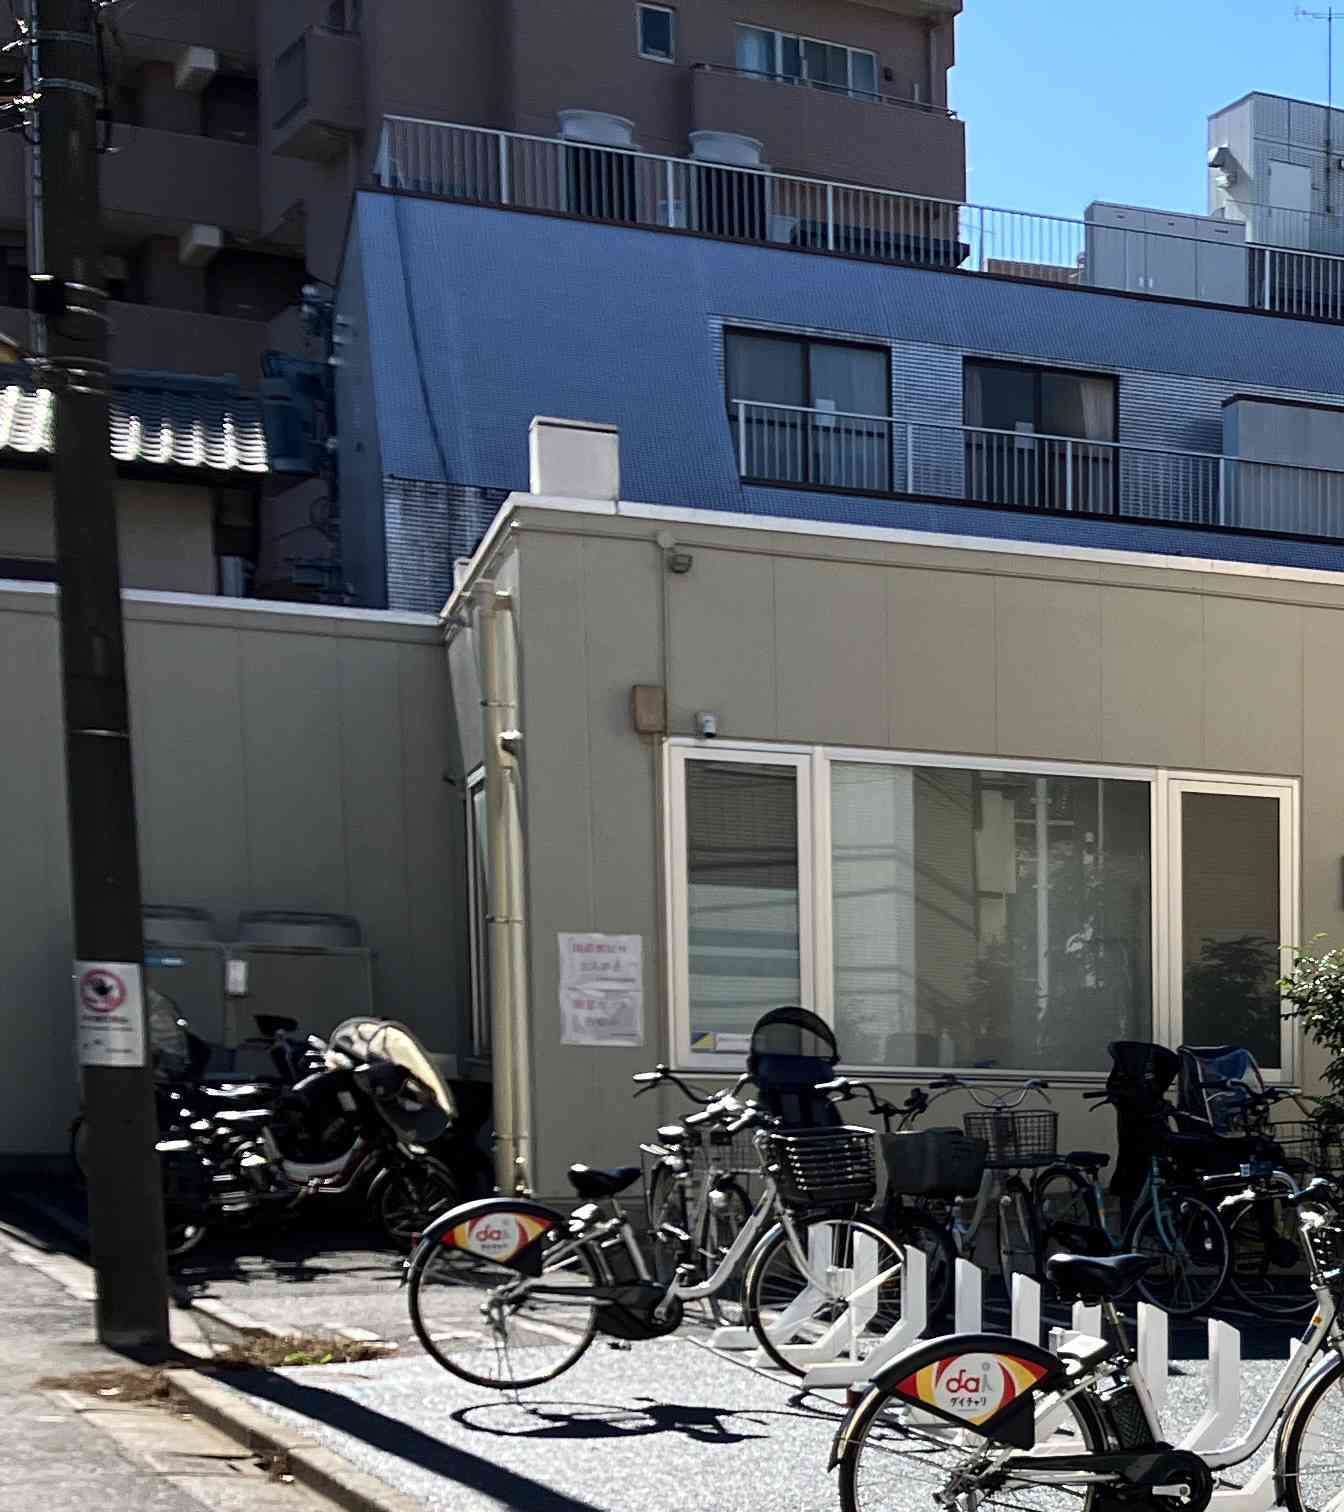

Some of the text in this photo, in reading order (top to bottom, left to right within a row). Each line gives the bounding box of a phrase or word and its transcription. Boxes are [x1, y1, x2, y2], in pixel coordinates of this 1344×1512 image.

[946, 1361, 993, 1393] dai
[950, 1396, 986, 1408] ダイチャリ
